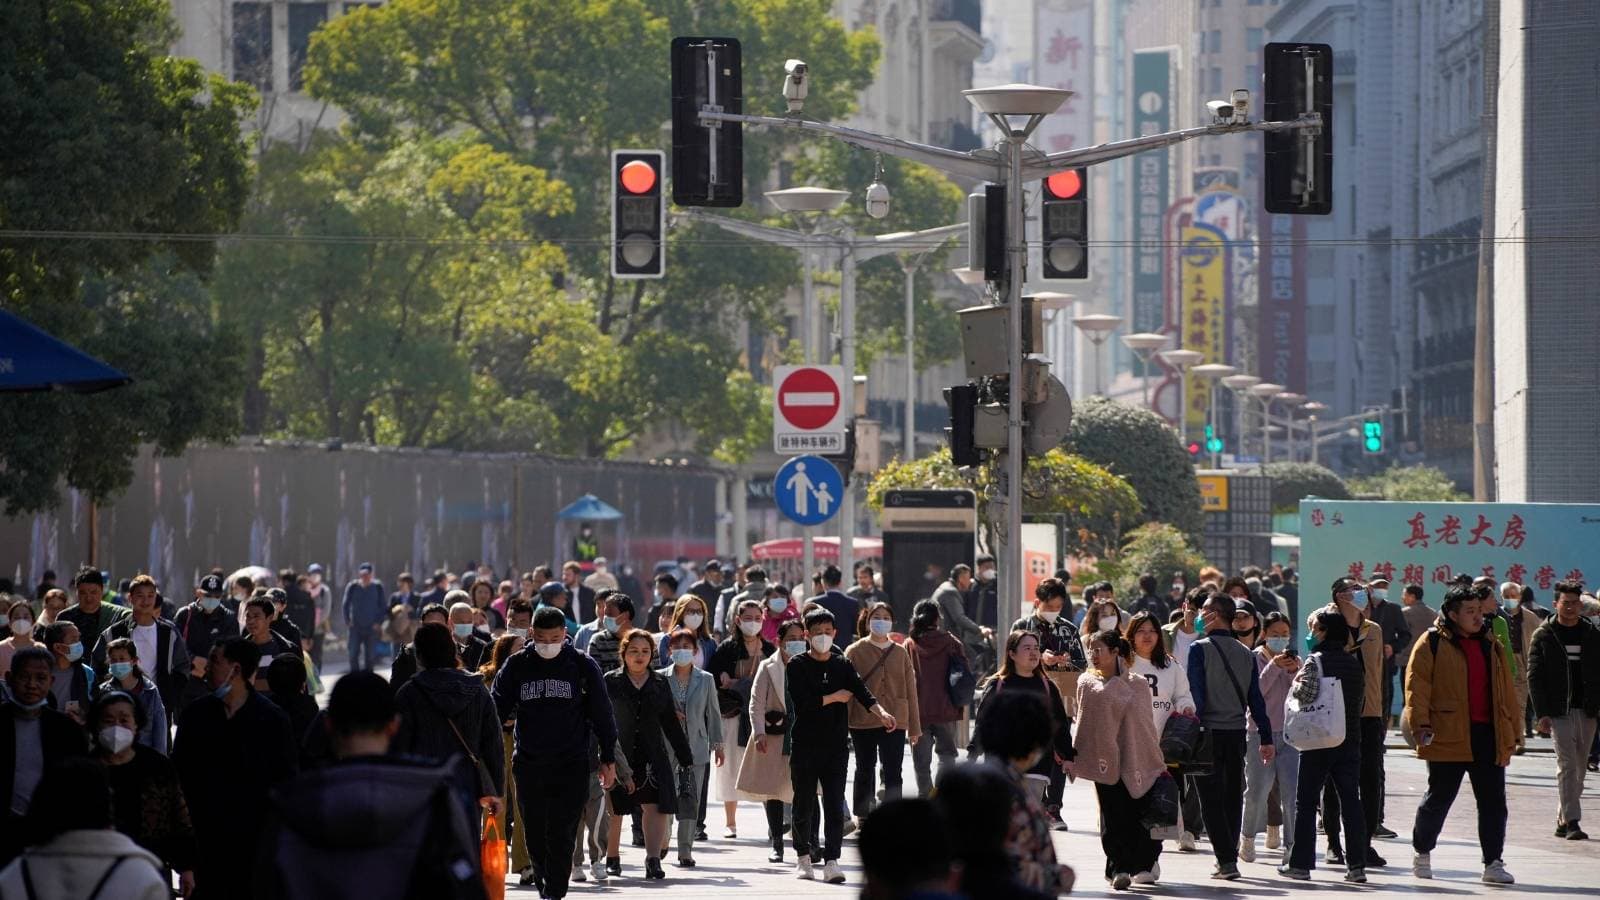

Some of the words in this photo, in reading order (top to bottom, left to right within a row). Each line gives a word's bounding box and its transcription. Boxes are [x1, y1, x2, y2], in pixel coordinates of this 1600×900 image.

[1403, 511, 1527, 550] 真老大房
[520, 680, 544, 701] GAP
